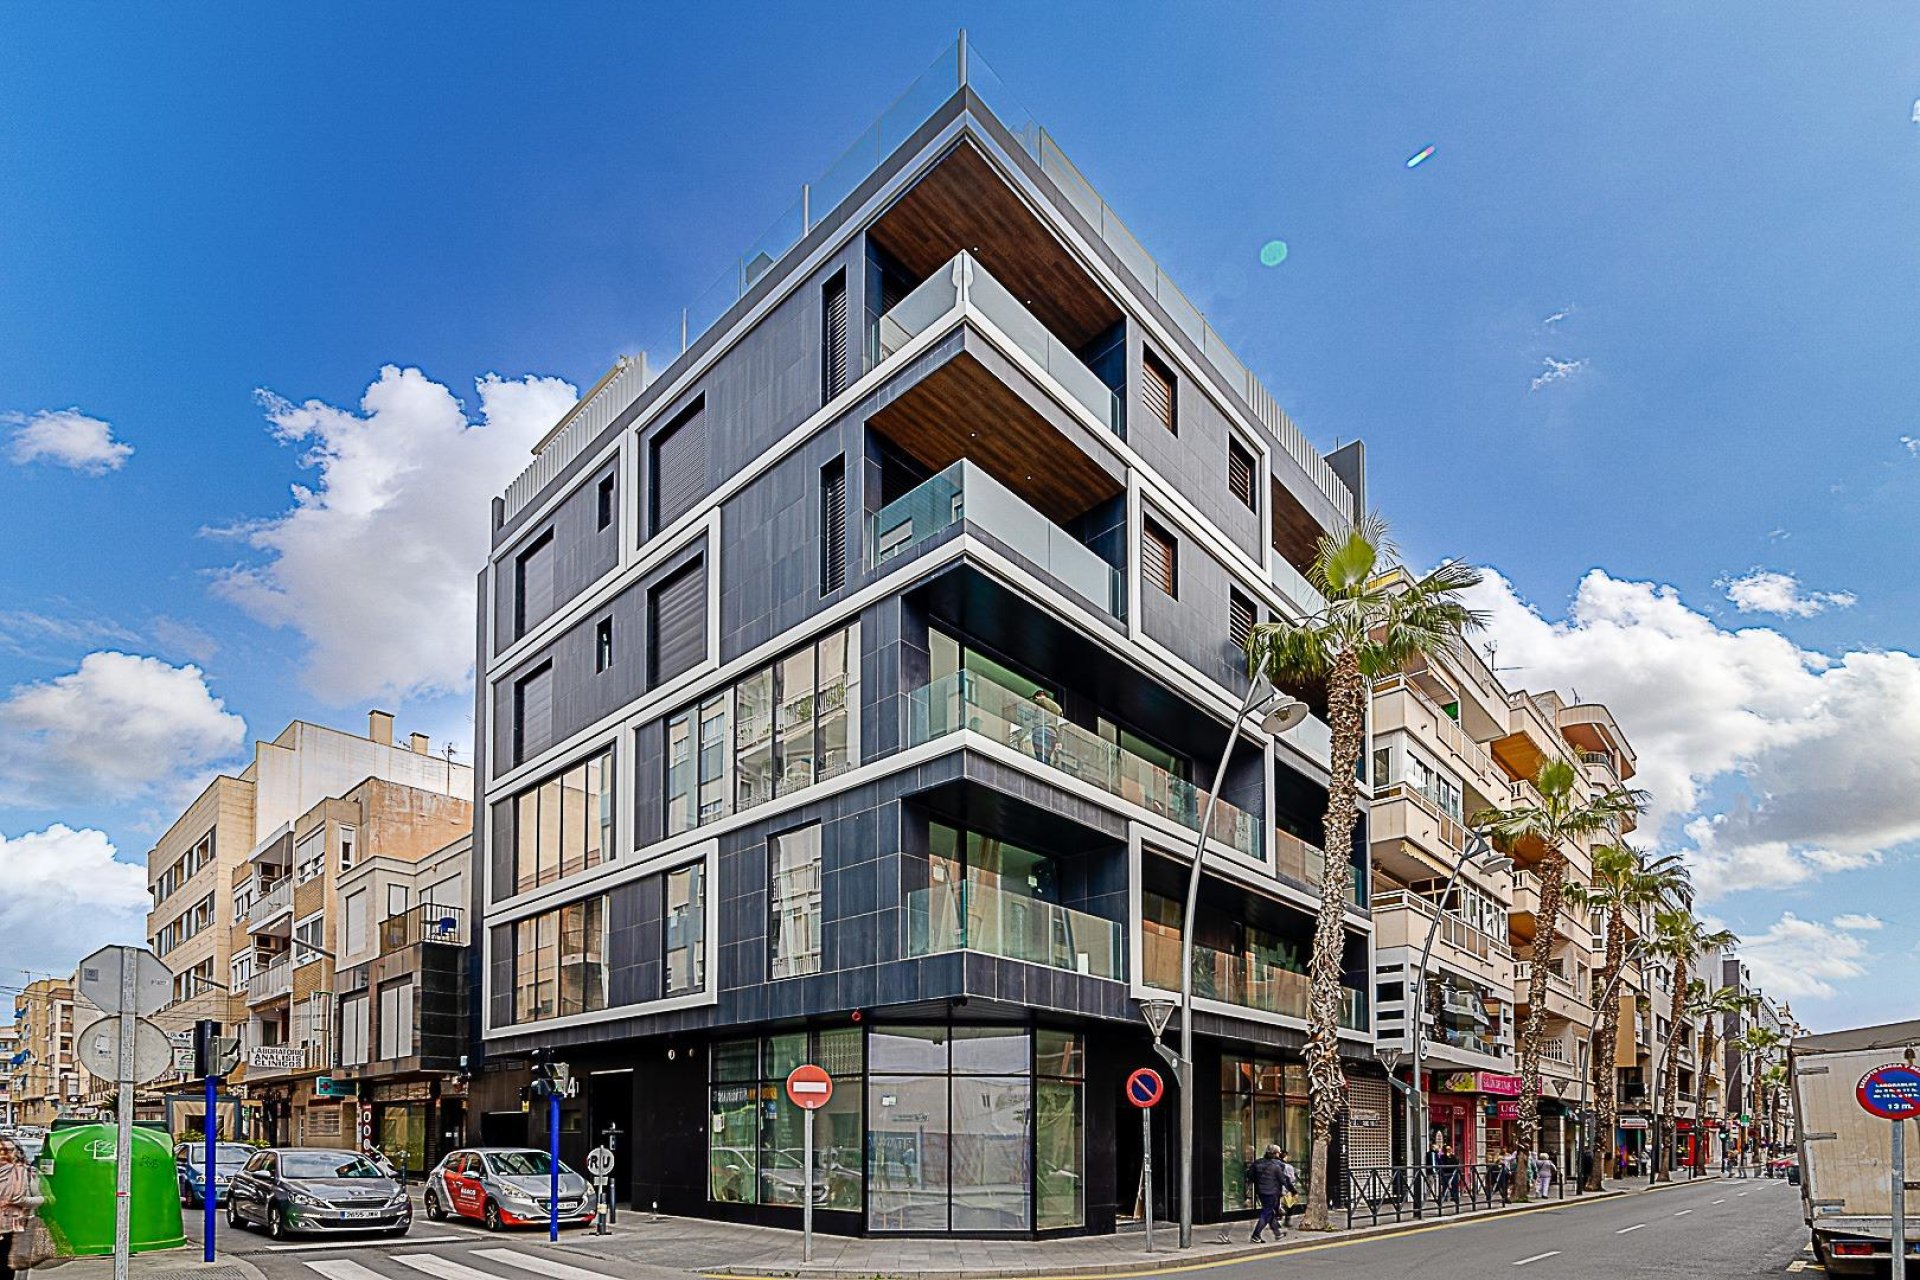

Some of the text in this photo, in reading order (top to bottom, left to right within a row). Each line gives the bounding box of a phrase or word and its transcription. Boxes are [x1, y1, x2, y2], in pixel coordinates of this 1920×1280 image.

[251, 1048, 304, 1056] LABORATORIO
[254, 1053, 302, 1062] ANALISIS
[254, 1059, 302, 1068] CLINICOS
